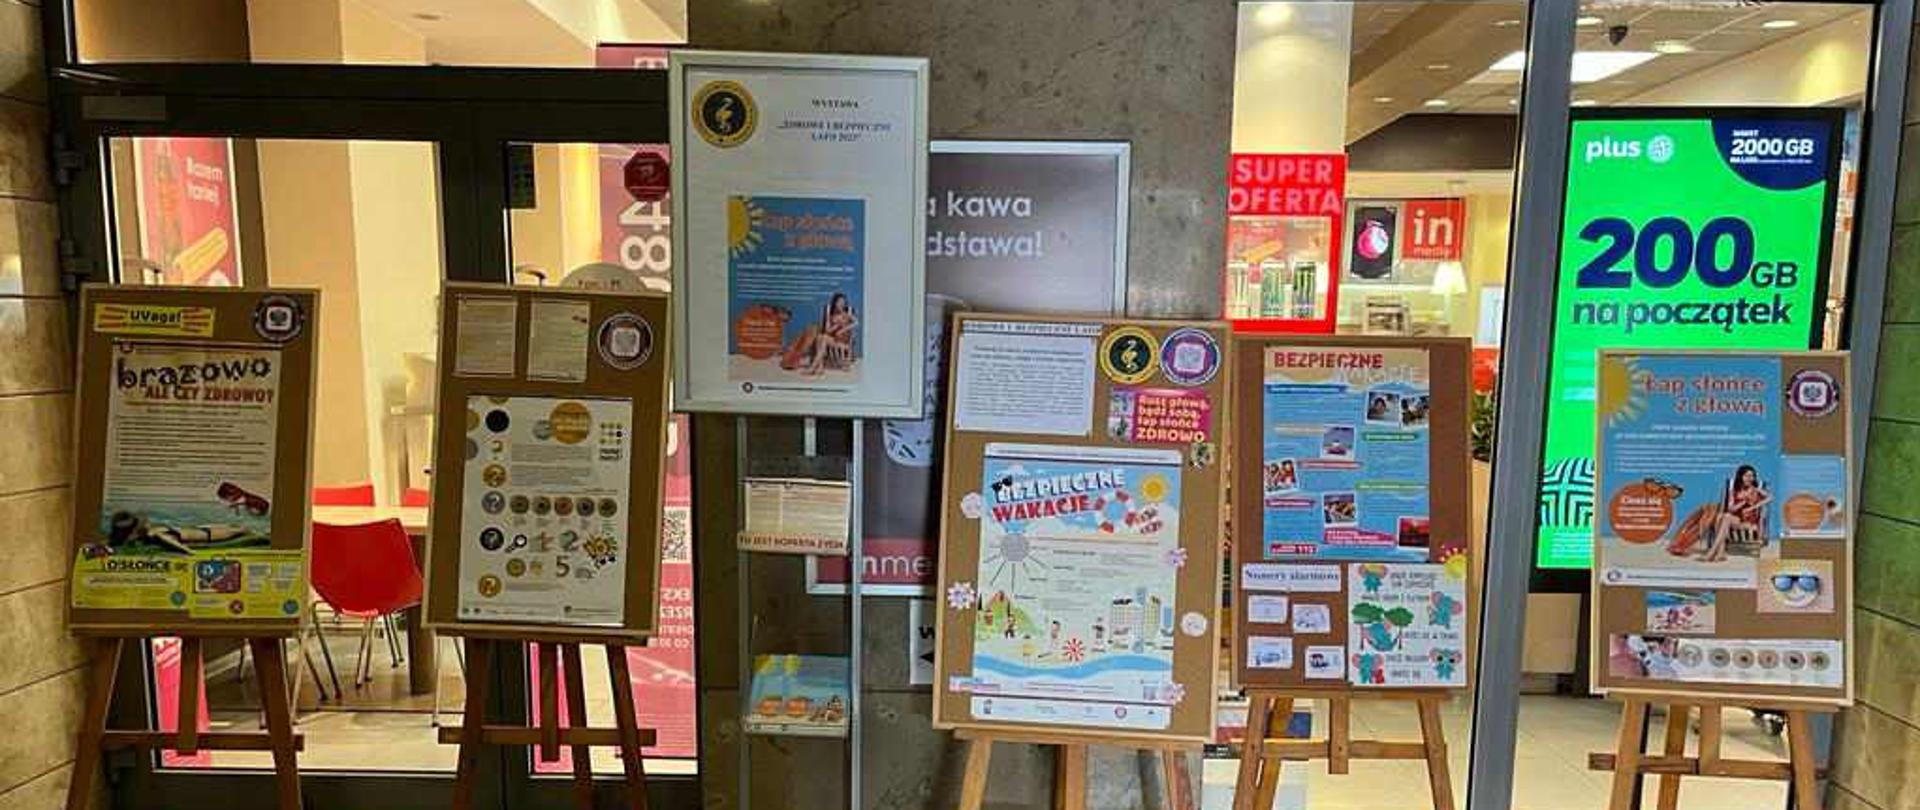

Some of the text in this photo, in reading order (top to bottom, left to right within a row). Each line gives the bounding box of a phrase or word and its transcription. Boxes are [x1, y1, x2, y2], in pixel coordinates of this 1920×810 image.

[1585, 136, 1641, 164] plus
[1731, 138, 1815, 156] 2000 GB
[1235, 159, 1333, 184] SUPER
[947, 190, 1032, 218] kawa
[1228, 187, 1342, 215] OFERTA
[1412, 209, 1454, 247] in
[1576, 216, 1798, 289] 200 GB
[1573, 294, 1793, 332] na początek
[117, 357, 273, 391] brązowo
[1274, 351, 1384, 369] BEZPIECZNE
[1135, 427, 1206, 442] ZDROWO
[1159, 416, 1199, 429] słońce
[992, 494, 1092, 524] WAKACJE
